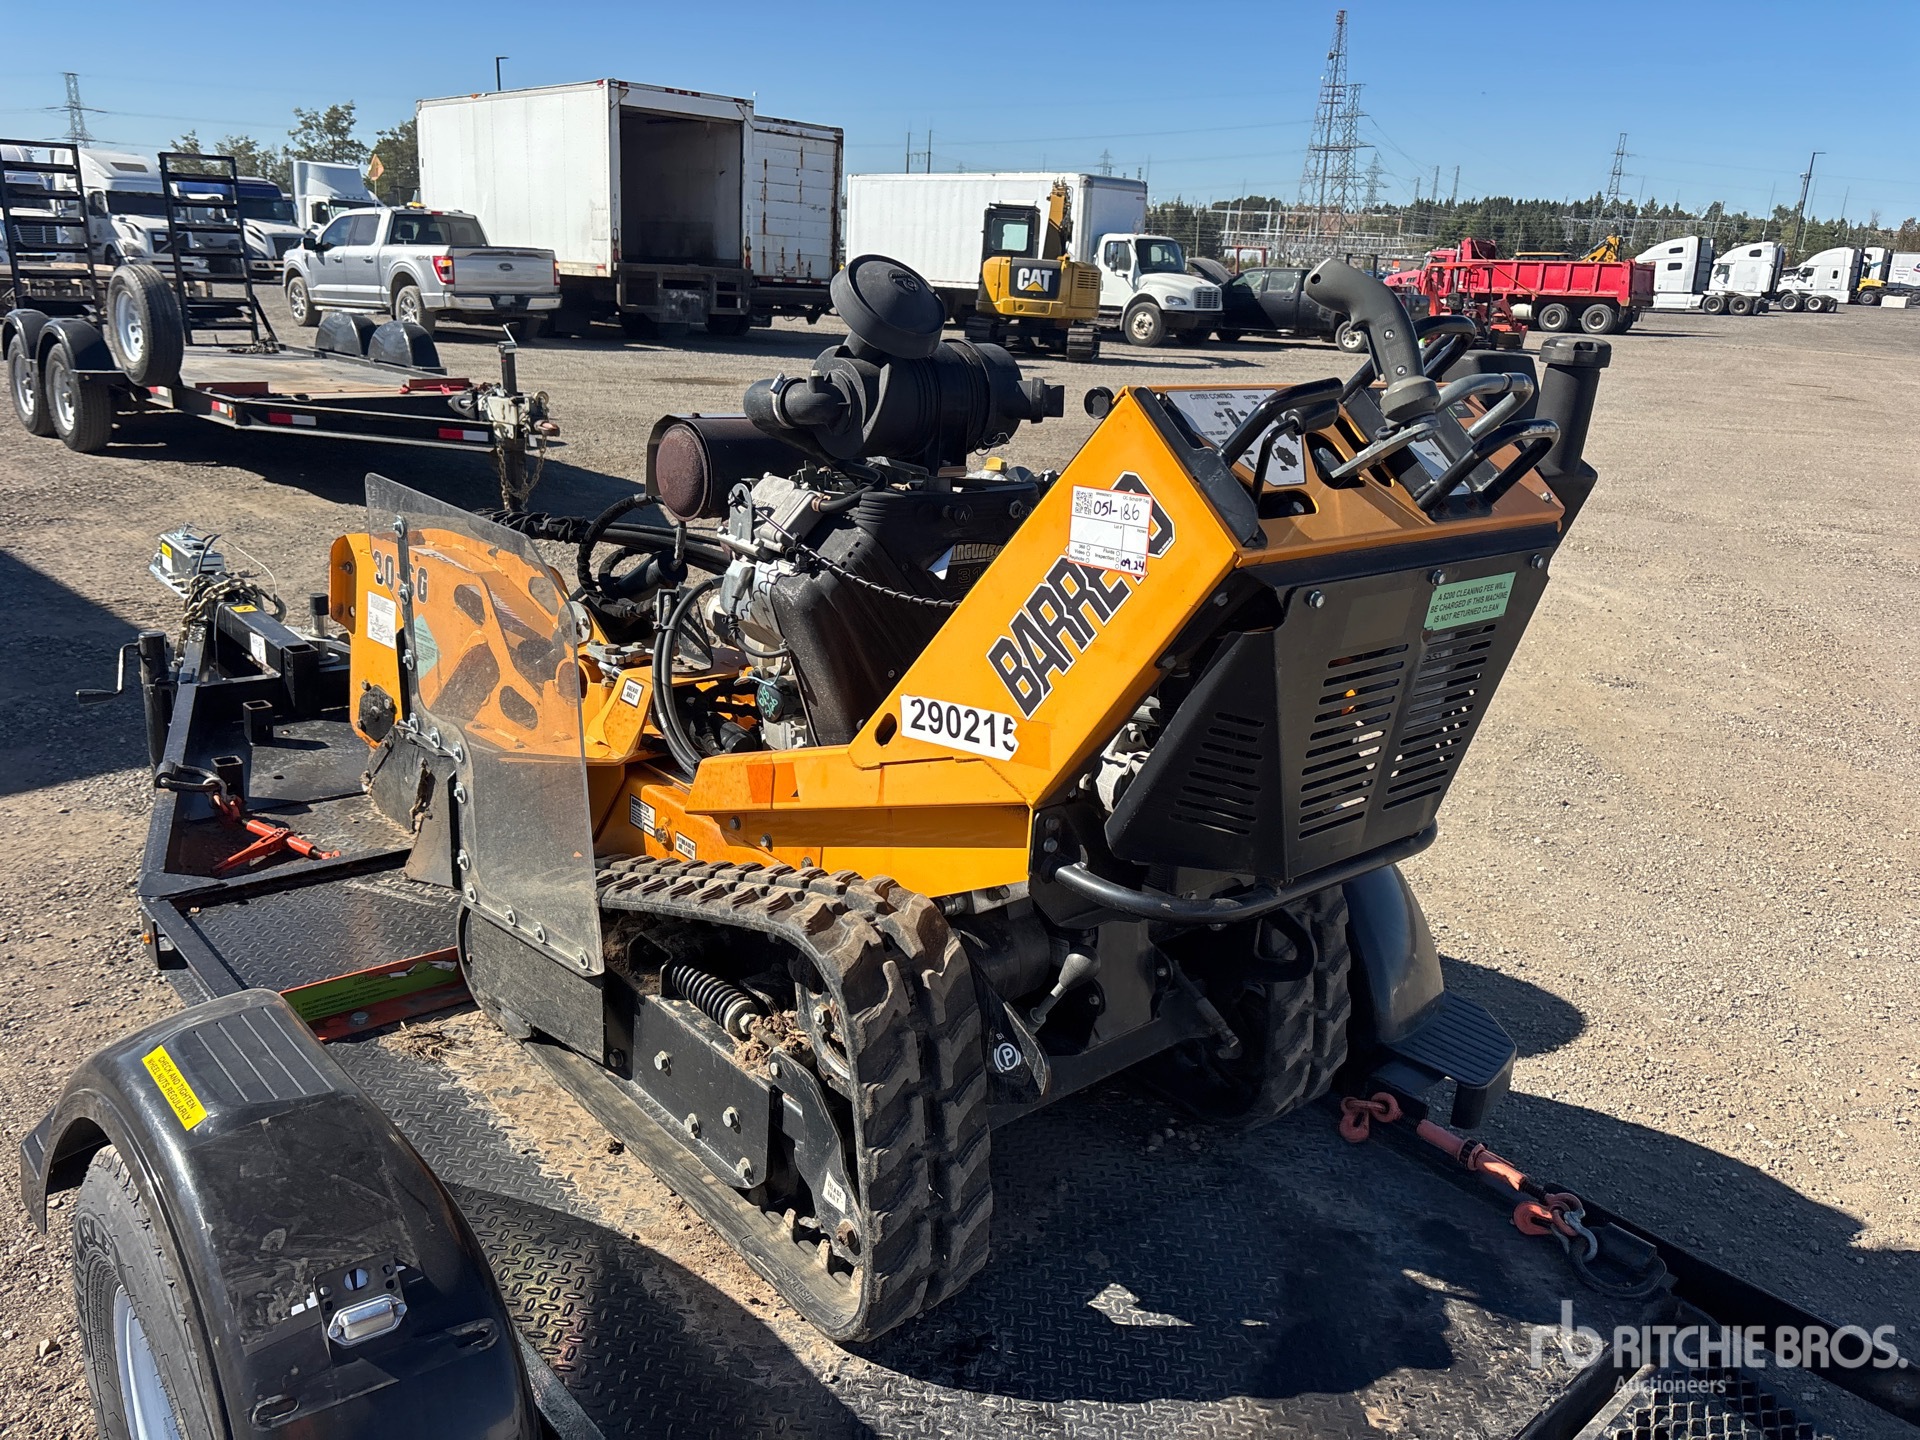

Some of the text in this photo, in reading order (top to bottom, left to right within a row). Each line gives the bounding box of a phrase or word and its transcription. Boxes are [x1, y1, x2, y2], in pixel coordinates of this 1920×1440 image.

[1017, 268, 1053, 292] CAT
[952, 543, 1004, 560] ANGUAR
[1094, 553, 1115, 561] Inspection
[987, 471, 1175, 720] BARREO
[1430, 591, 1508, 614] BE CHARGED IF THIS MACHINE
[1437, 582, 1507, 601] A $200 CLEANING FEE WILL
[1433, 603, 1499, 623] IS NOT RETURNED CLEAN
[910, 698, 1016, 753] 290215
[147, 1058, 192, 1121] WHEEL NUTS REGULARLY
[157, 1055, 197, 1110] CHECK AND TIGHTEN
